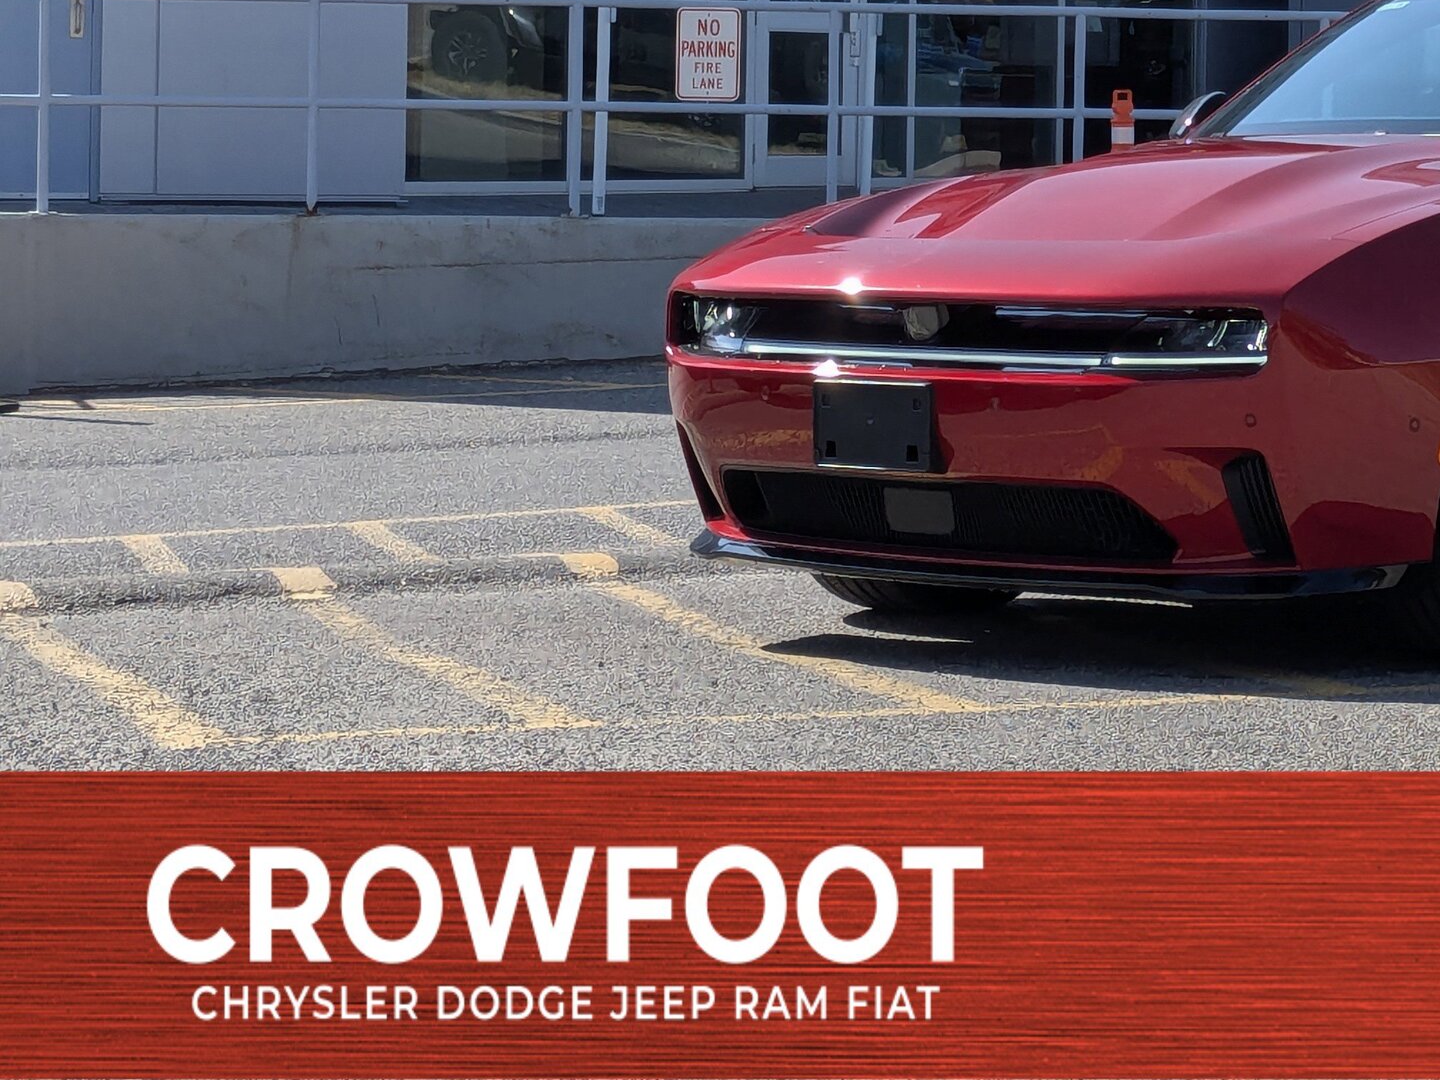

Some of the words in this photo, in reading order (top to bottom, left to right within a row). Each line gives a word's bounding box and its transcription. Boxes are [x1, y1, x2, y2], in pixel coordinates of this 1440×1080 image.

[697, 18, 720, 37] NO
[681, 40, 735, 58] PARKING
[694, 61, 722, 75] FIRE
[692, 77, 723, 90] LANE
